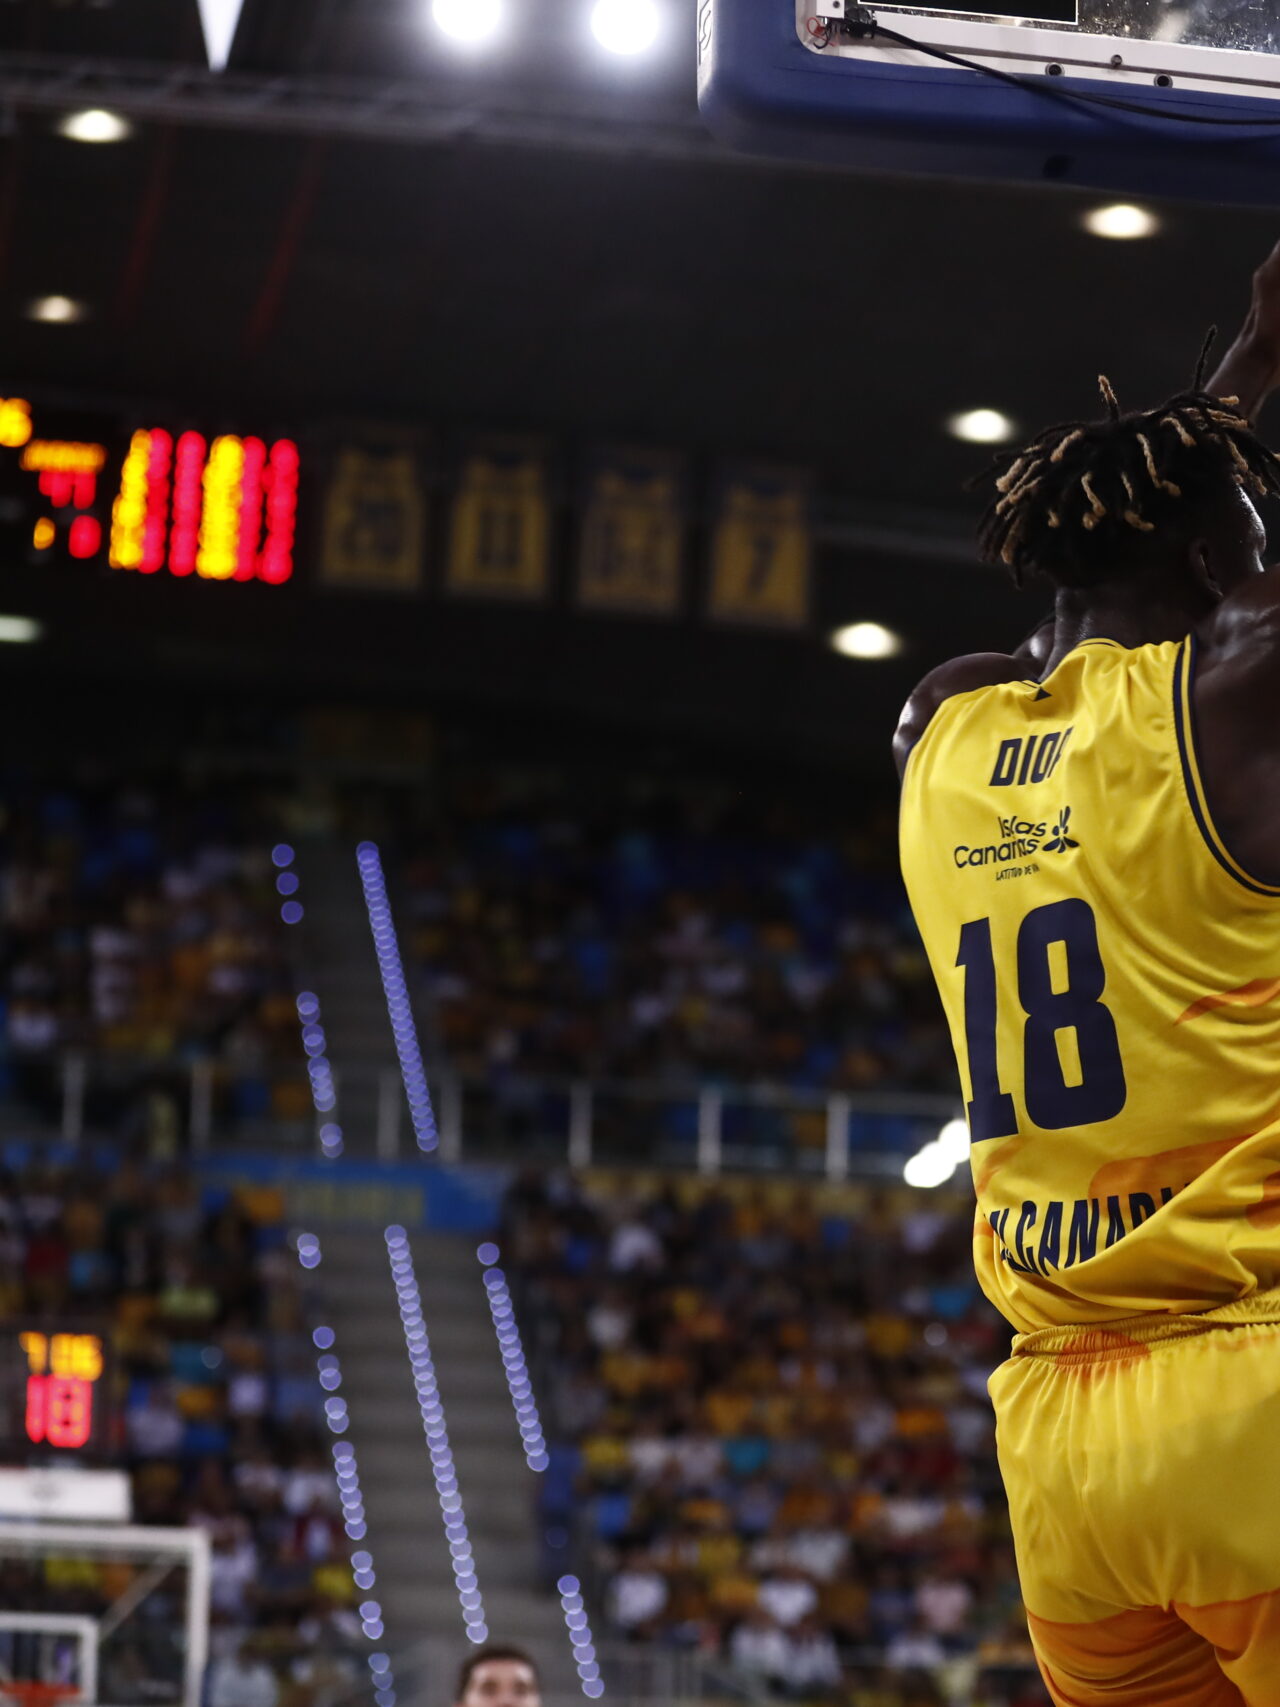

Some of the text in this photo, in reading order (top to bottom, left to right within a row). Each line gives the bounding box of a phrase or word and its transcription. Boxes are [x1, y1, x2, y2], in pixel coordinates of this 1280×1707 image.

[997, 815, 1047, 838] Islas
[955, 897, 1127, 1144] 18
[1013, 1181, 1192, 1278] CANAR
